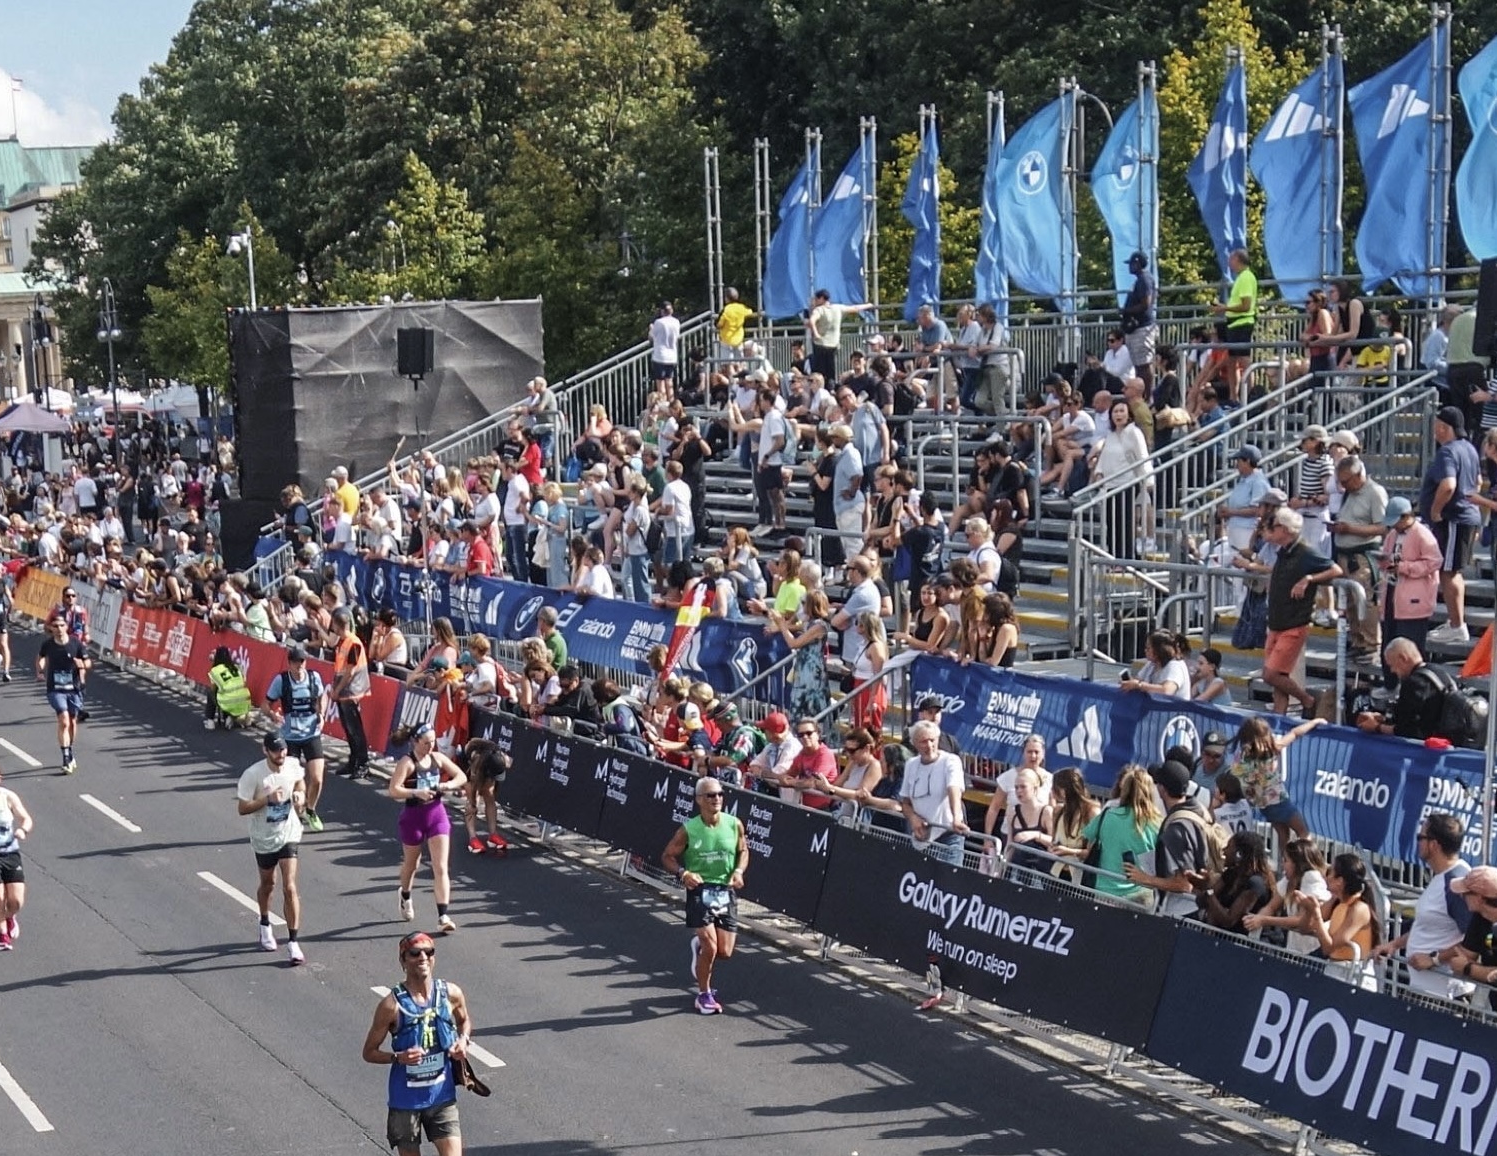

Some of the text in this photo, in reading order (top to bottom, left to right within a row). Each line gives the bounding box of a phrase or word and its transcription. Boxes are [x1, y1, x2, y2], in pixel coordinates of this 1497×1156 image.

[578, 618, 615, 639] zalando
[987, 691, 1021, 715] BMW
[981, 712, 1016, 730] BERLIN
[1314, 769, 1390, 809] zalando
[1425, 776, 1475, 812] BMW
[749, 804, 773, 821] Maurten
[746, 819, 771, 839] Hydrogel
[746, 834, 774, 858] echnology
[899, 871, 968, 929] Galaxy
[926, 929, 1018, 984] We run on sleep
